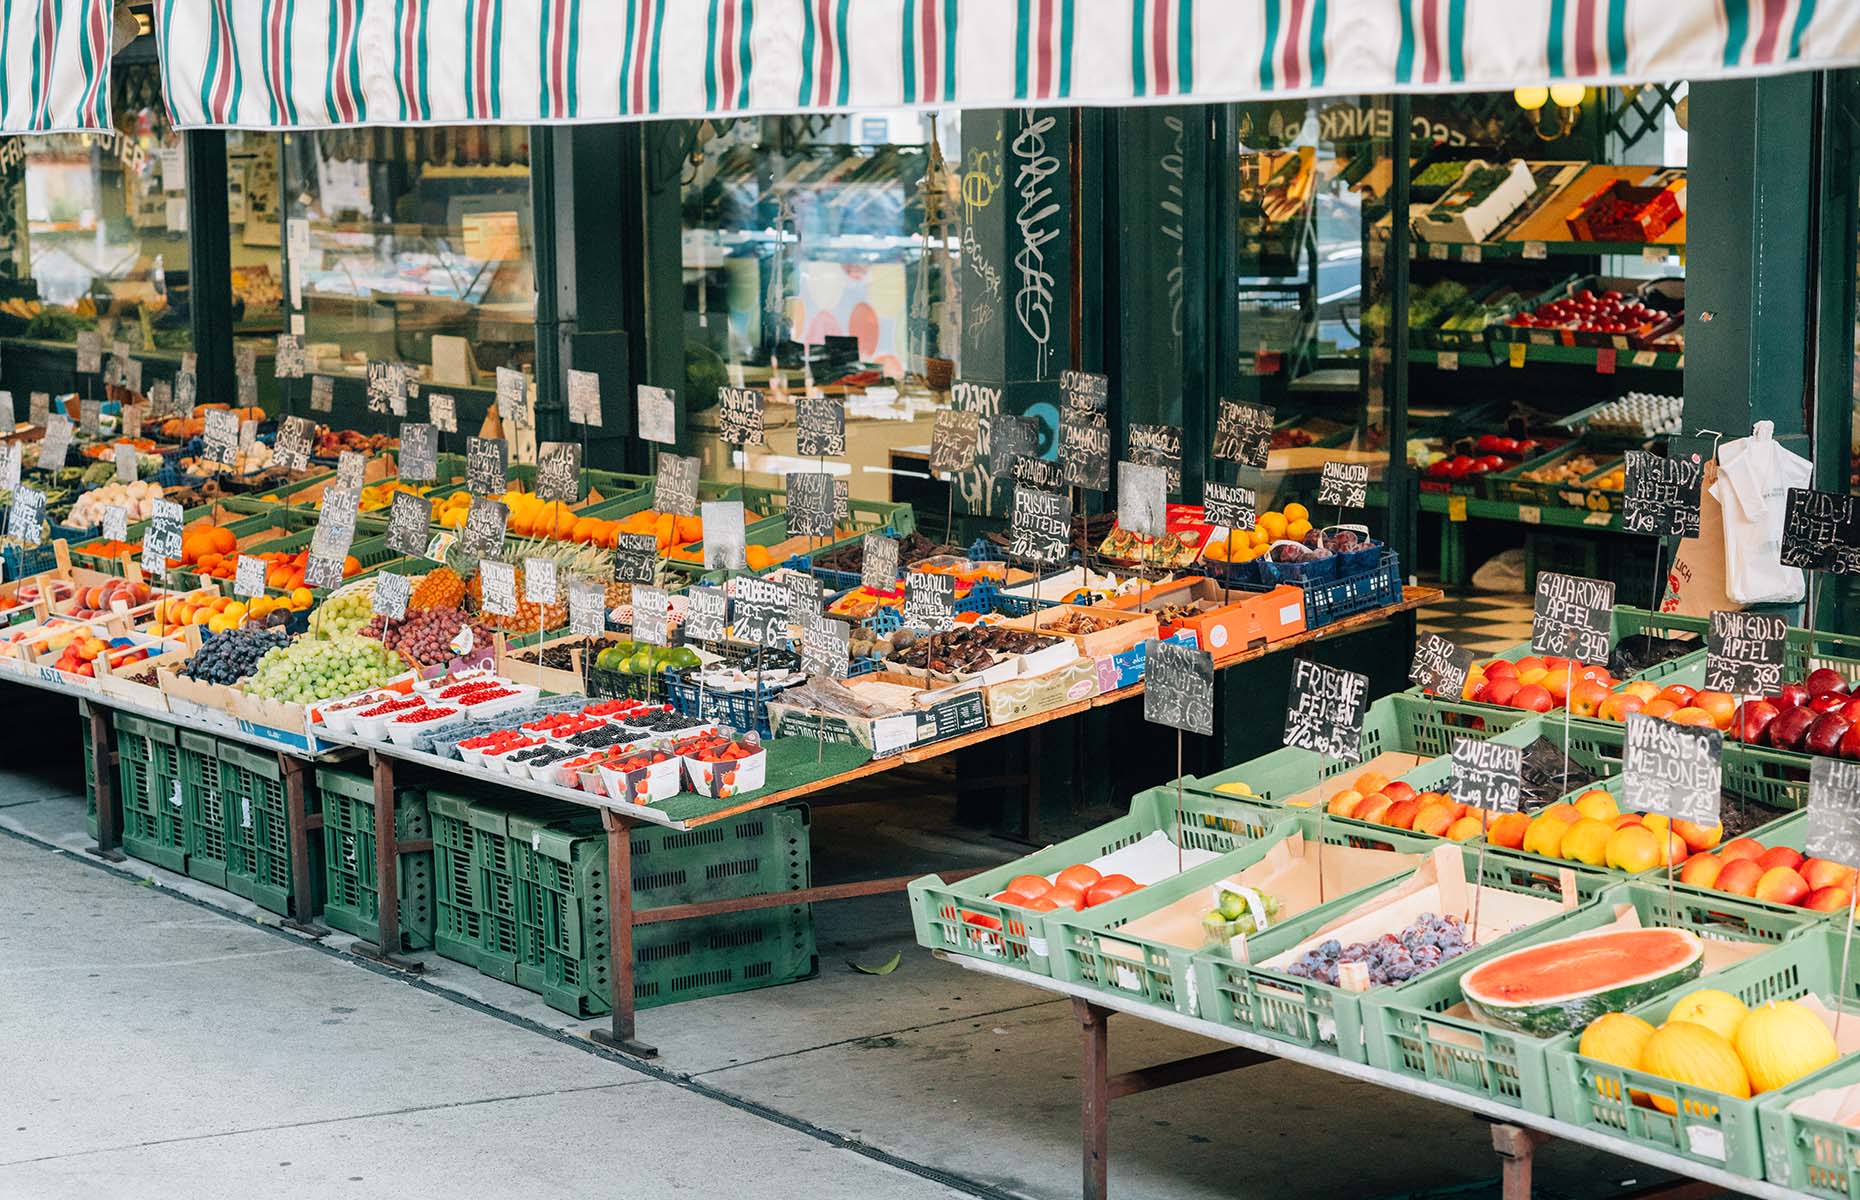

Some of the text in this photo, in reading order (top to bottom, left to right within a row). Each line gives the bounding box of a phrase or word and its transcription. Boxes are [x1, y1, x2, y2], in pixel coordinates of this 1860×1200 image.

[722, 389, 763, 415] NAVEL
[719, 408, 764, 431] ORANGEN
[1323, 461, 1369, 481] RINGLOTEN
[1015, 491, 1061, 517] FRISCHE
[912, 591, 944, 607] HONIG
[1427, 634, 1455, 659] BIO
[40, 667, 65, 685] ASTA
[1415, 645, 1467, 686] ZITRONEN
[1296, 660, 1365, 706] FRISCHE
[1298, 692, 1356, 726] FEIGEN
[1454, 737, 1522, 774] ZWECKEN
[1627, 745, 1723, 790] MELONEN
